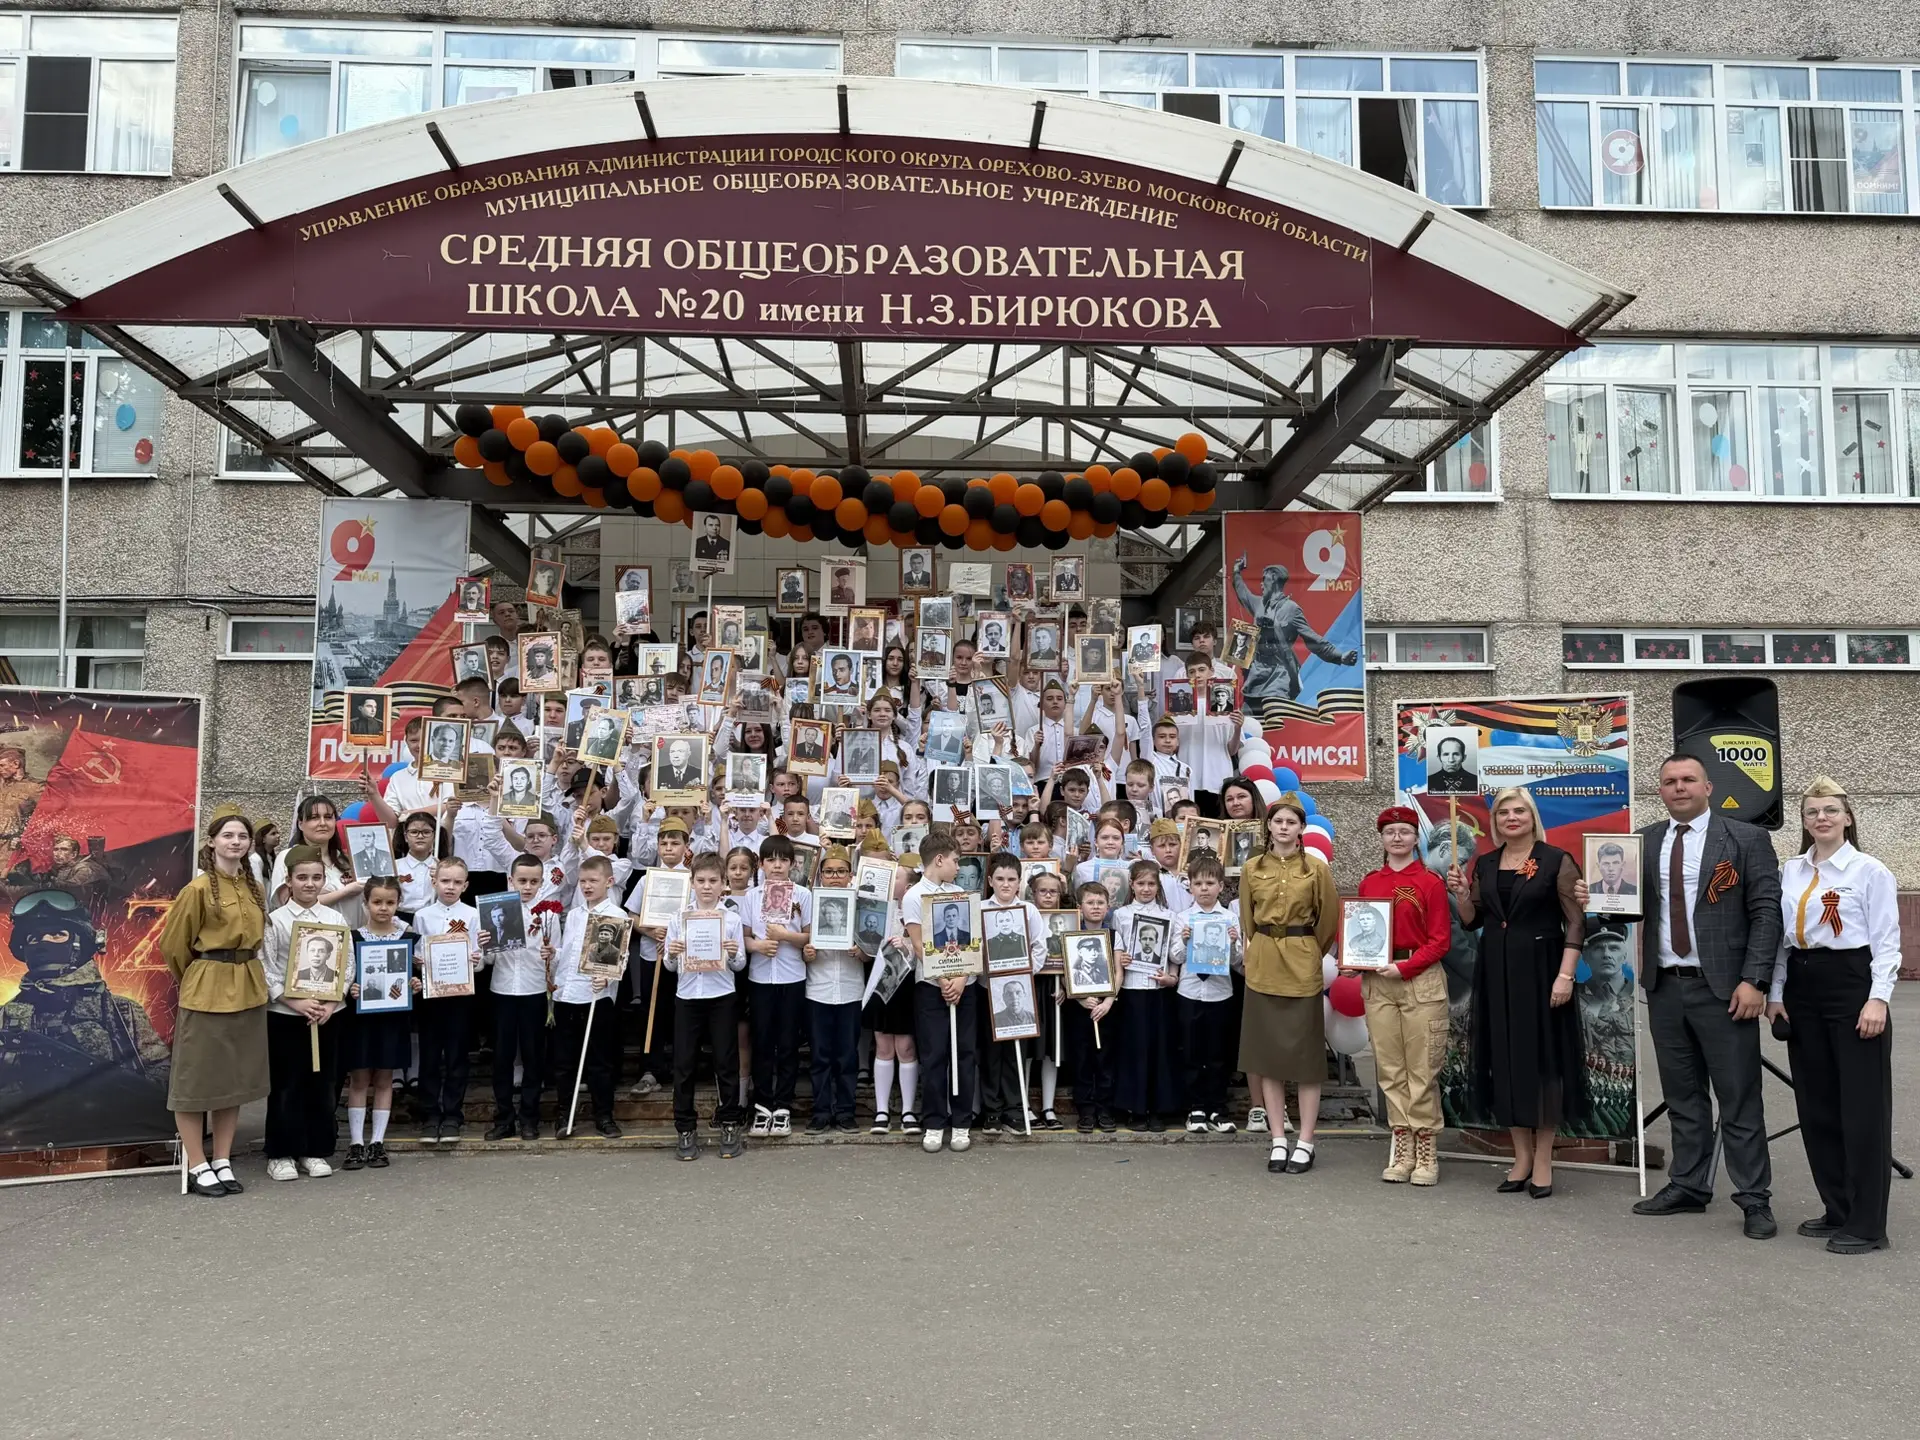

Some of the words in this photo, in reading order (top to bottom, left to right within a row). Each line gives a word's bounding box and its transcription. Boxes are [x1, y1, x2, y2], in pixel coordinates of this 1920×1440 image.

[299, 191, 431, 242] УПРАВЛЕНИЕ
[434, 161, 580, 201] ОБРАЗОВАНИЯ
[585, 148, 765, 174] АДМИНИСТРАЦИИ
[769, 147, 896, 166] ГОРОДСКОГО
[900, 151, 973, 170] ОКРУГА
[979, 157, 1142, 193] ОРЕХОВО-ЗУЕВО
[1146, 182, 1279, 231] МОСКОВСКОЙ
[1281, 221, 1368, 263] ОБЛАСТИ
[485, 174, 702, 218] МУНИЦИПАЛЬНОЕ
[713, 172, 1014, 202] ОБЩЕОБРАЗОВАТЕЛЬНОЕ
[1022, 186, 1179, 230] УЧРЕЖДЕНИЕ
[440, 234, 652, 273] СРЕДНЯЯ
[663, 239, 1245, 280] ОБЩЕОБРАЗОВАТЕЛЬНАЯ
[467, 284, 640, 318] ШКОЛА
[655, 287, 745, 321] №20
[759, 301, 864, 324] имени
[881, 294, 1222, 330] Н.З.БИРЮКОВА
[330, 519, 376, 582] 9
[1303, 529, 1347, 592] 9
[1326, 579, 1353, 592] МАЯ
[1483, 765, 1524, 775] такая
[1527, 761, 1607, 777] профессия
[1716, 747, 1768, 762] 1000
